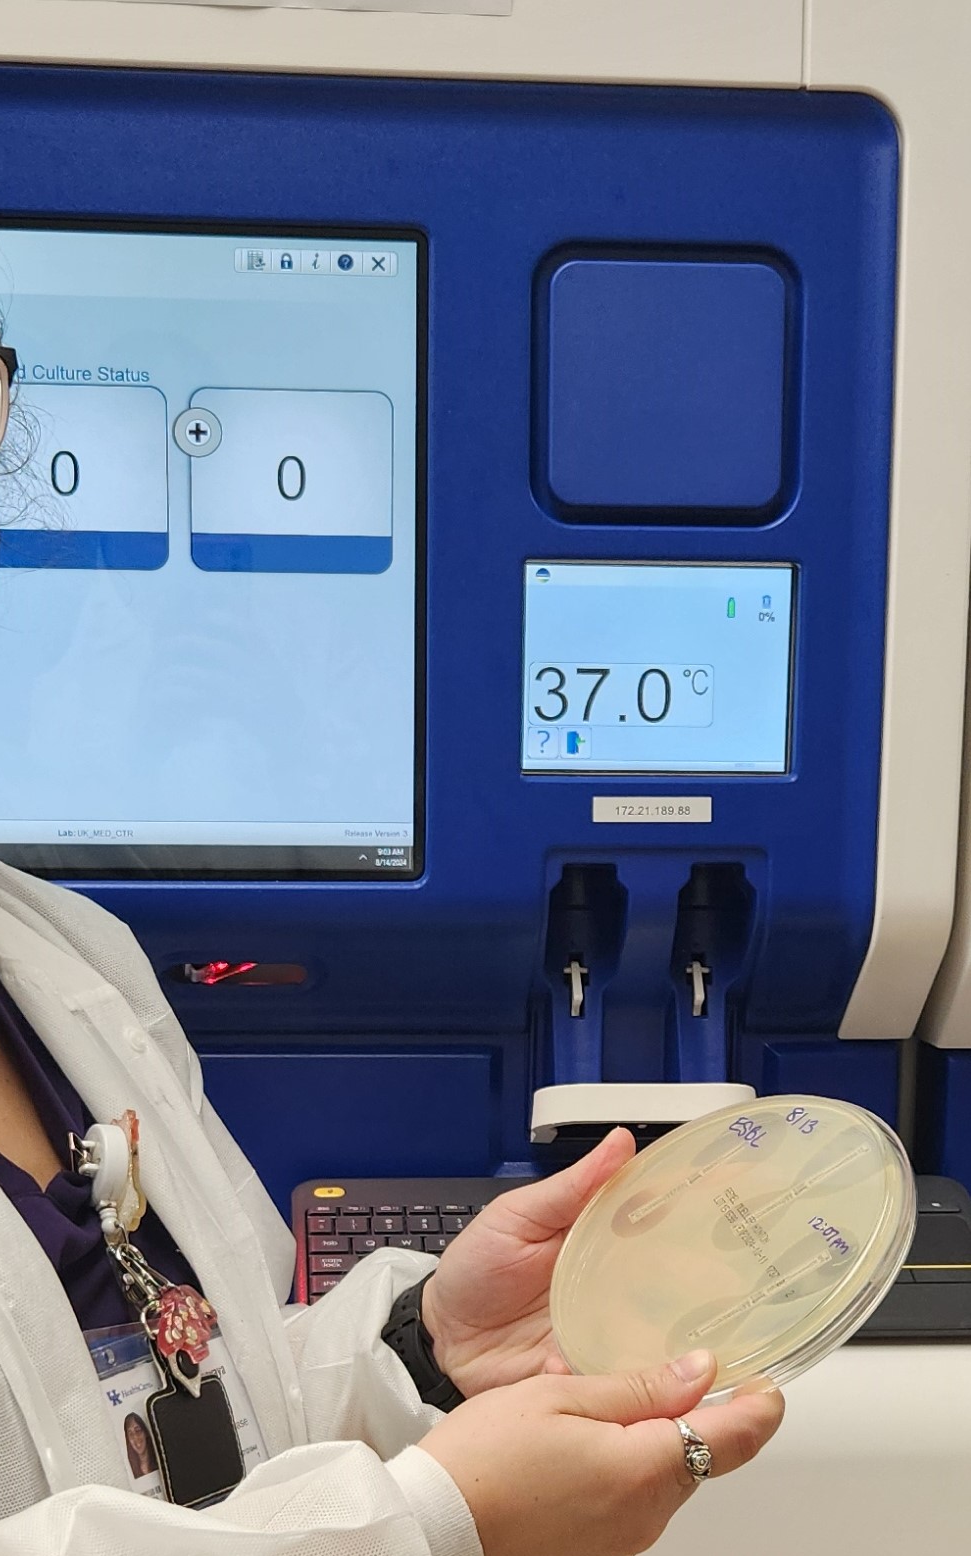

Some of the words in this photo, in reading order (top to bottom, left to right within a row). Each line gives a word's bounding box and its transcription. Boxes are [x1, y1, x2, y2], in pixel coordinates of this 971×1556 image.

[31, 363, 92, 381] Culture
[97, 366, 150, 382] Status
[50, 450, 79, 496] 0
[277, 455, 306, 501] 0
[758, 611, 776, 623] 0%
[534, 666, 671, 724] 37.0
[614, 805, 691, 817] 172.21.189.88
[58, 829, 76, 838] Lab:
[77, 829, 134, 840] UK_MED_CTR
[344, 829, 373, 839] Release
[374, 829, 401, 839] Version
[729, 1117, 767, 1148] ESBL
[785, 1107, 819, 1135] 8/13
[808, 1216, 840, 1241] 12:07
